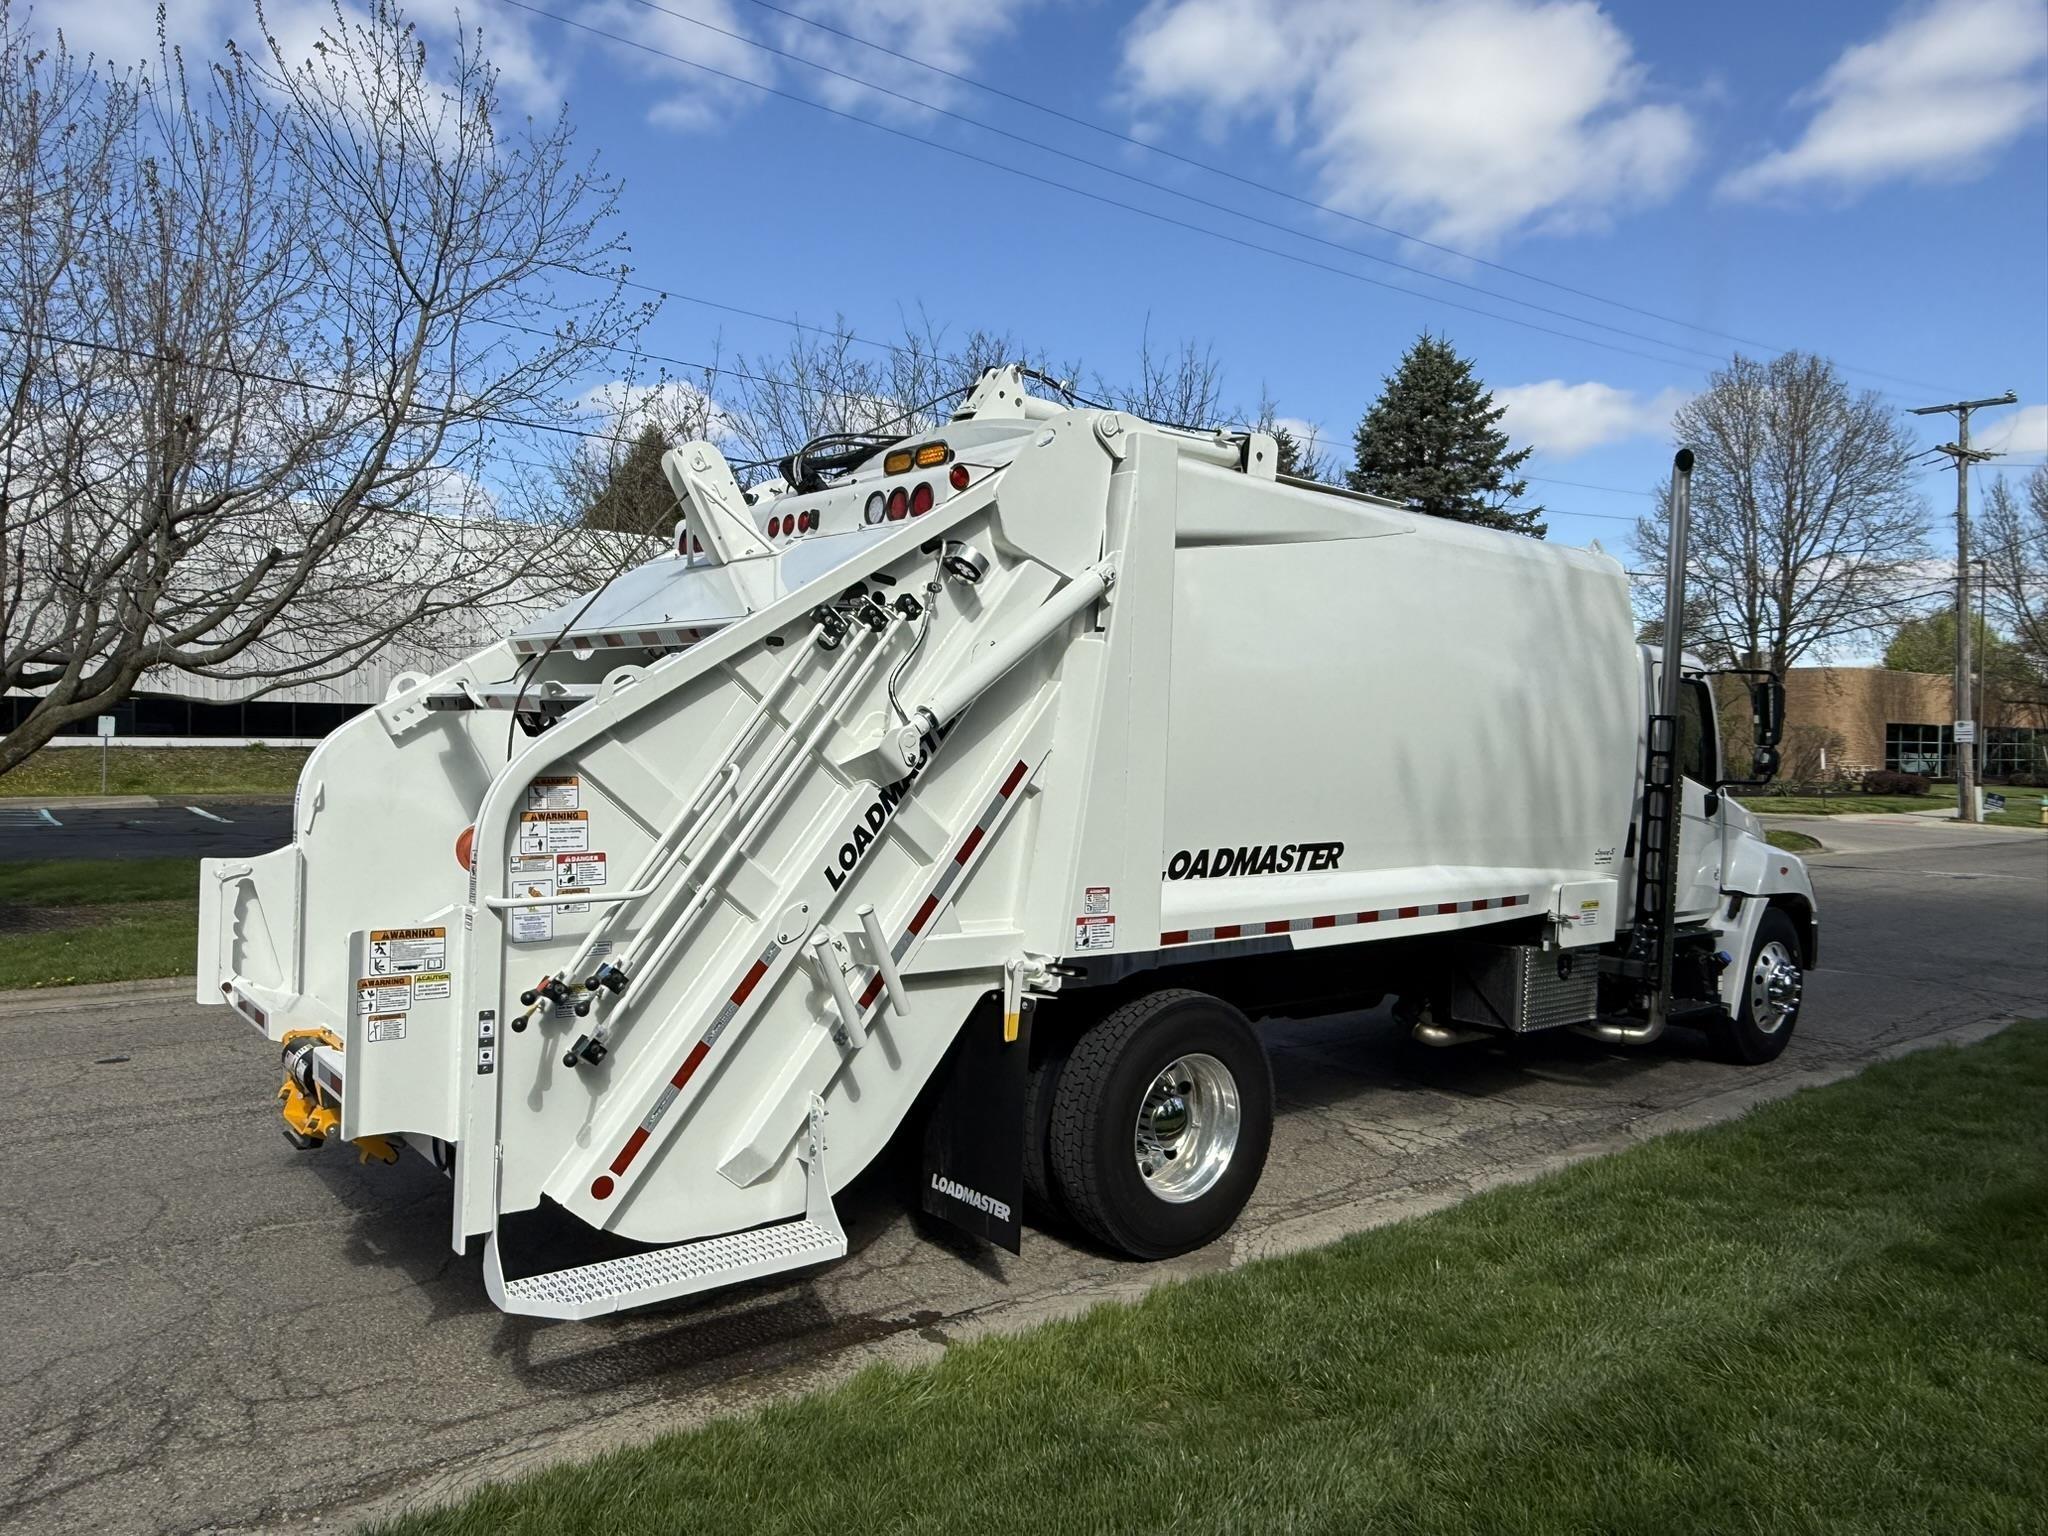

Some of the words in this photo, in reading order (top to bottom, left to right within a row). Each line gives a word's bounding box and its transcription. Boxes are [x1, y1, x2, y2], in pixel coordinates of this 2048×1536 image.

[538, 812, 579, 821] WARNING
[1162, 842, 1345, 881] OADMASTER
[391, 929, 436, 939] WARNING
[368, 978, 405, 987] WARNING
[931, 1173, 1011, 1223] LOADMASTER
